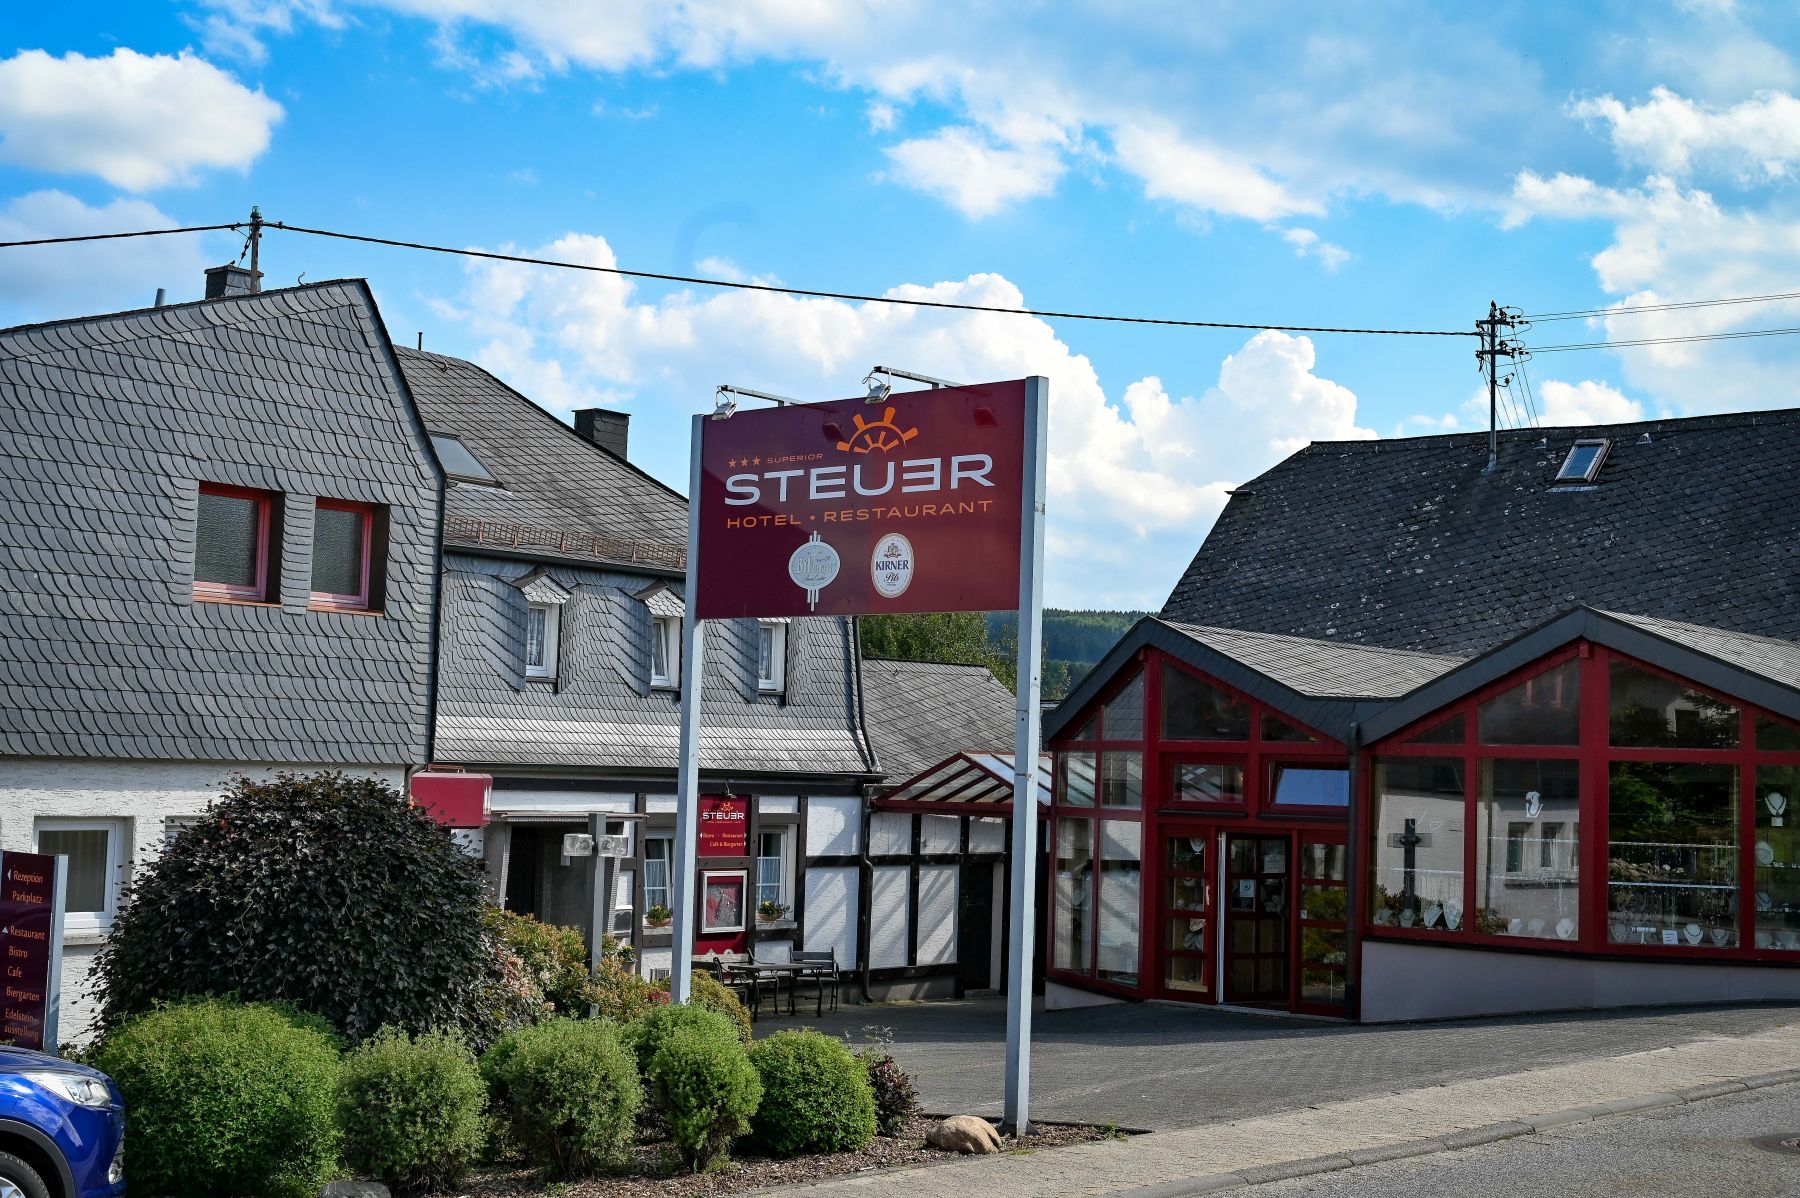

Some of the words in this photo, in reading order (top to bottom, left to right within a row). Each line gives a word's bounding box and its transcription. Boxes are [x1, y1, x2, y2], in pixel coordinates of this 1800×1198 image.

[767, 453, 824, 465] SUPERIOR
[724, 453, 996, 506] STEUER
[727, 514, 802, 529] HOTEL
[824, 500, 993, 523] RESTAURANT
[875, 559, 910, 572] KIRNER
[883, 572, 901, 583] Pils
[702, 812, 745, 820] STEUER
[13, 870, 43, 885] Rezeption
[12, 890, 43, 905] Parkplatz
[10, 925, 46, 940] Restaurant
[8, 945, 28, 958] Bistro
[6, 986, 40, 1002] Biergarten
